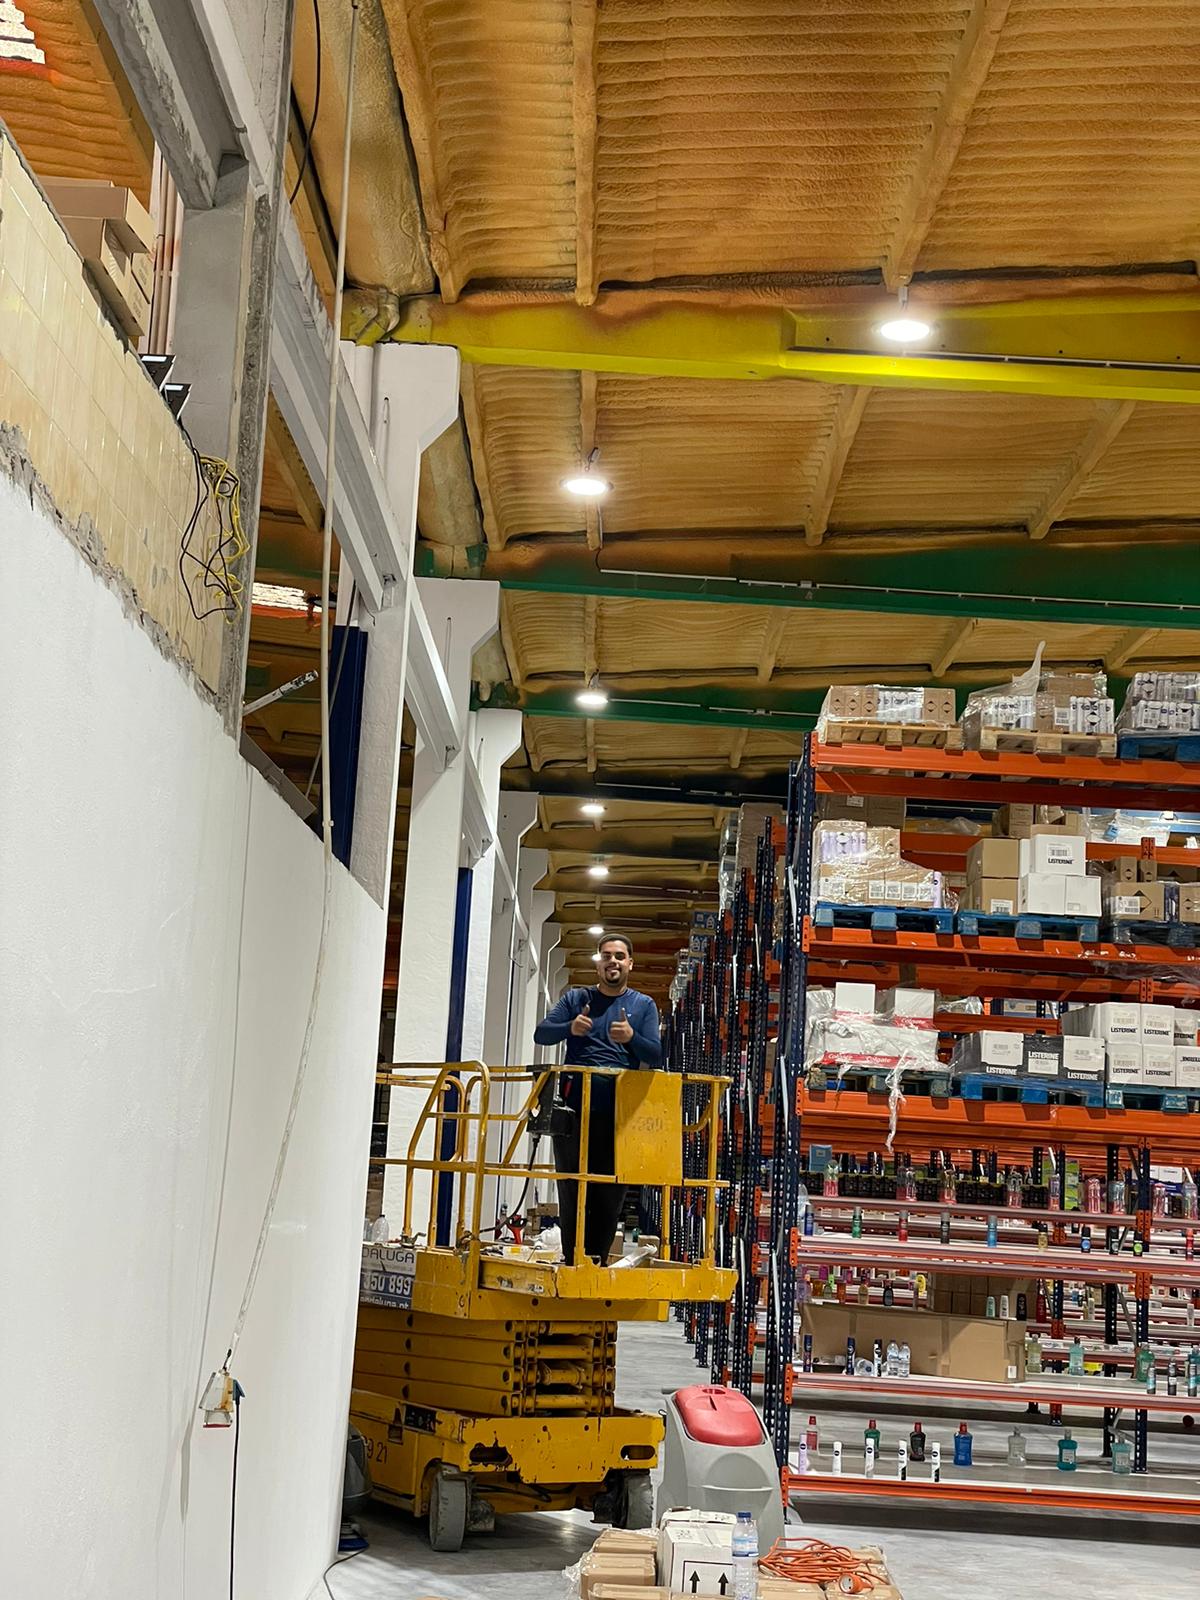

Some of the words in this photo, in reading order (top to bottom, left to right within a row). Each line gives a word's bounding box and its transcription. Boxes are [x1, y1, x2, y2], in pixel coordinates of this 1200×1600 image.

[1028, 1051, 1059, 1060] LISTERINE
[986, 1066, 1017, 1075] LISTERINE
[1145, 1069, 1173, 1077] LISTERINE
[1067, 1072, 1098, 1081] LISTERINE
[388, 1274, 412, 1295] 899
